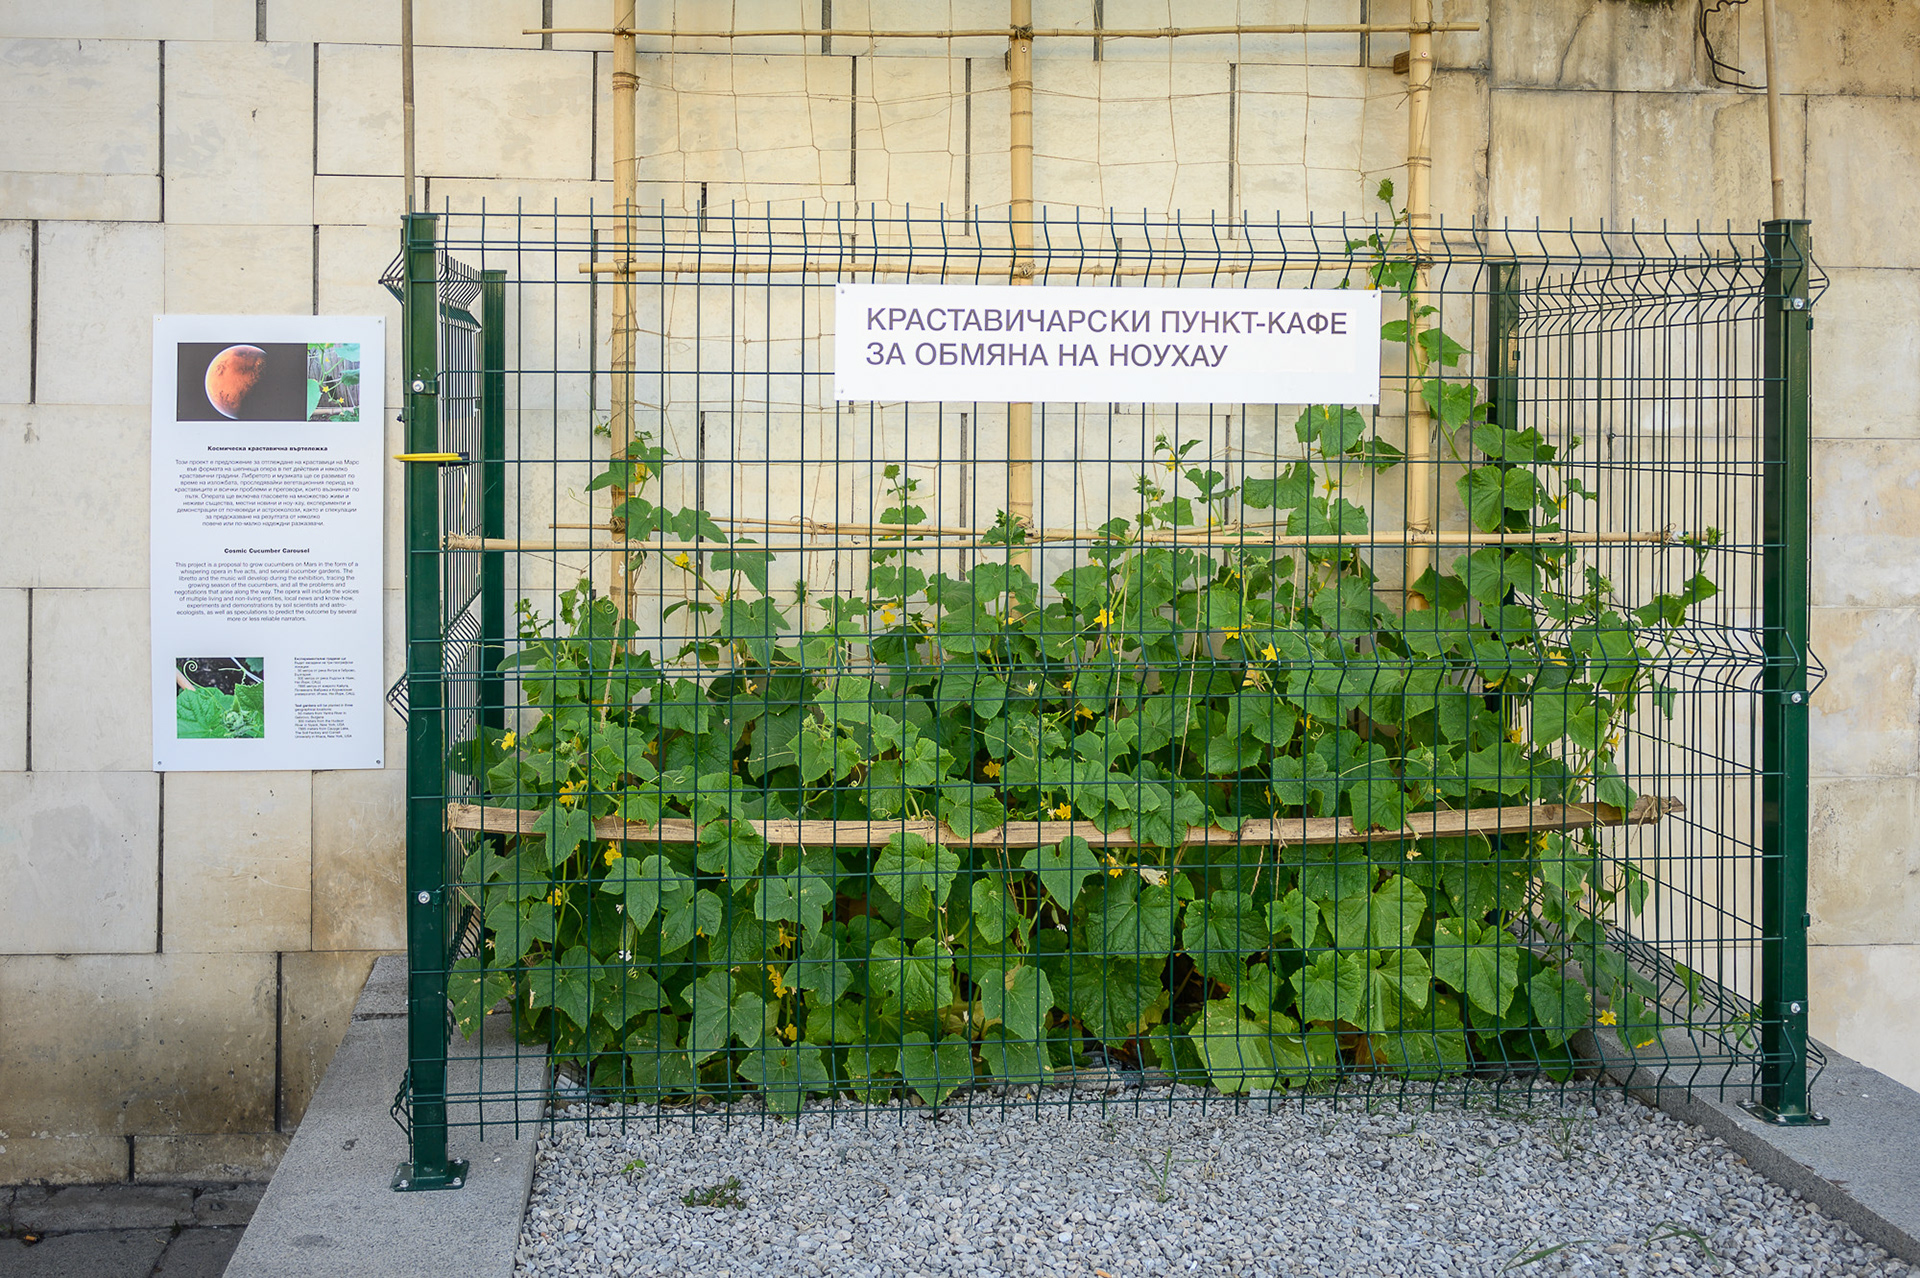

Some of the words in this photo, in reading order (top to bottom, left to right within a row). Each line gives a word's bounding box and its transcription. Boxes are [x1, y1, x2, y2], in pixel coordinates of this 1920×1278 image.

[868, 308, 1149, 332] КРАСТАВИЧАРСКИ
[1162, 311, 1346, 334] ПУНКТ-КАФЕ
[867, 342, 905, 365] ЗА
[916, 343, 1048, 365] ОБМЯНА
[1059, 344, 1098, 366] НА
[1111, 344, 1228, 367] НОУХАУ
